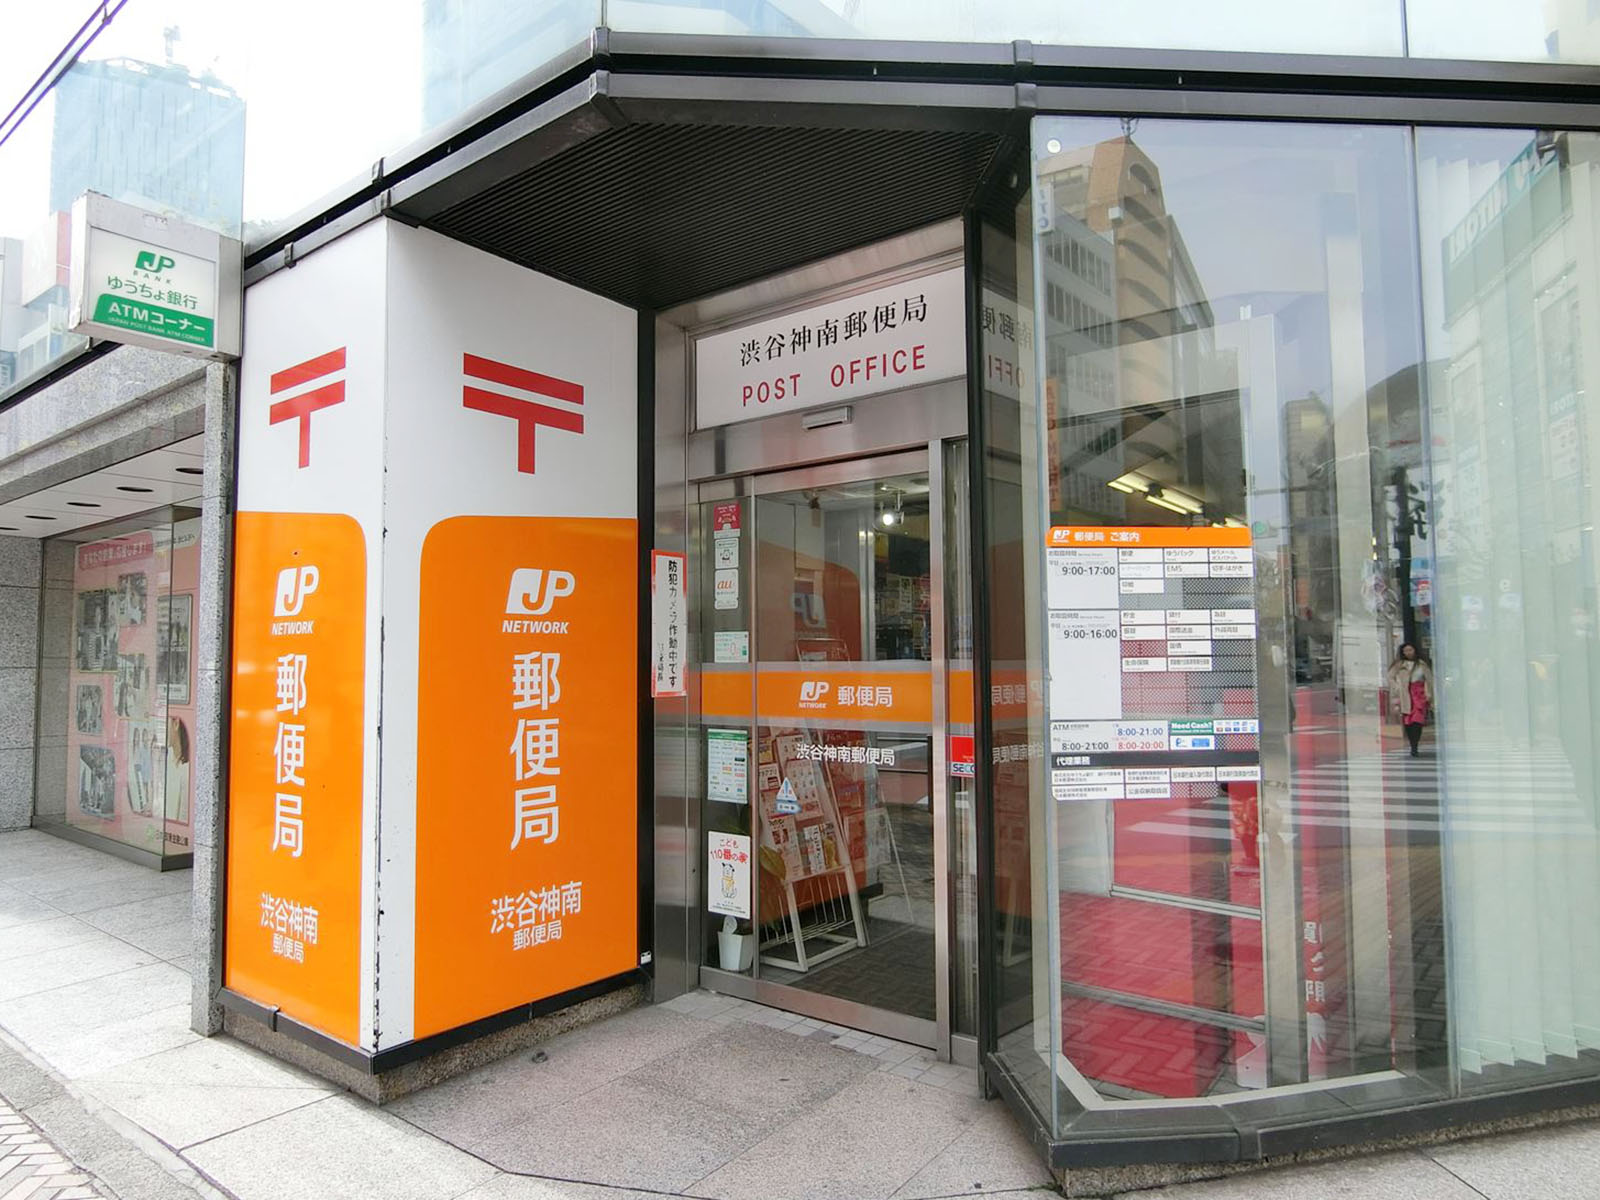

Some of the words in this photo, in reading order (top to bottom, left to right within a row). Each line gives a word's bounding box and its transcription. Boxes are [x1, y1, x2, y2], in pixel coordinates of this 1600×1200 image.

[135, 250, 175, 273] JP
[133, 270, 172, 284] BANK
[107, 275, 198, 310] ゆうちょ銀行
[108, 302, 206, 331] ATMコーナー
[740, 294, 928, 367] 渋谷神南郵便局
[742, 373, 801, 407] POST
[830, 344, 926, 388] OFFICE
[1062, 566, 1116, 576] 9:00-17:00
[274, 565, 320, 617] JP
[505, 568, 576, 615] JP
[717, 580, 732, 590] au
[272, 620, 315, 635] NETWORK
[502, 620, 569, 634] NETWORK
[668, 560, 678, 688] 防犯カメラ作動中です
[1063, 629, 1118, 639] 9:00-16:00
[801, 681, 829, 700] JP
[837, 686, 893, 708] 郵便局
[1118, 728, 1163, 736] 8:00-21:00
[272, 653, 307, 858] 郵便局
[509, 651, 561, 850] 郵便局
[796, 743, 895, 766] 渋谷神南郵便局
[1062, 742, 1109, 751] 8:00-21:00
[1118, 741, 1164, 750] 8:00-20:00
[719, 838, 739, 849] こども
[710, 848, 748, 864] 110番の家
[260, 892, 319, 945] 渋谷神南
[489, 880, 583, 934] 渋谷神南
[513, 920, 563, 951] 郵便局
[272, 932, 304, 964] 郵便局
